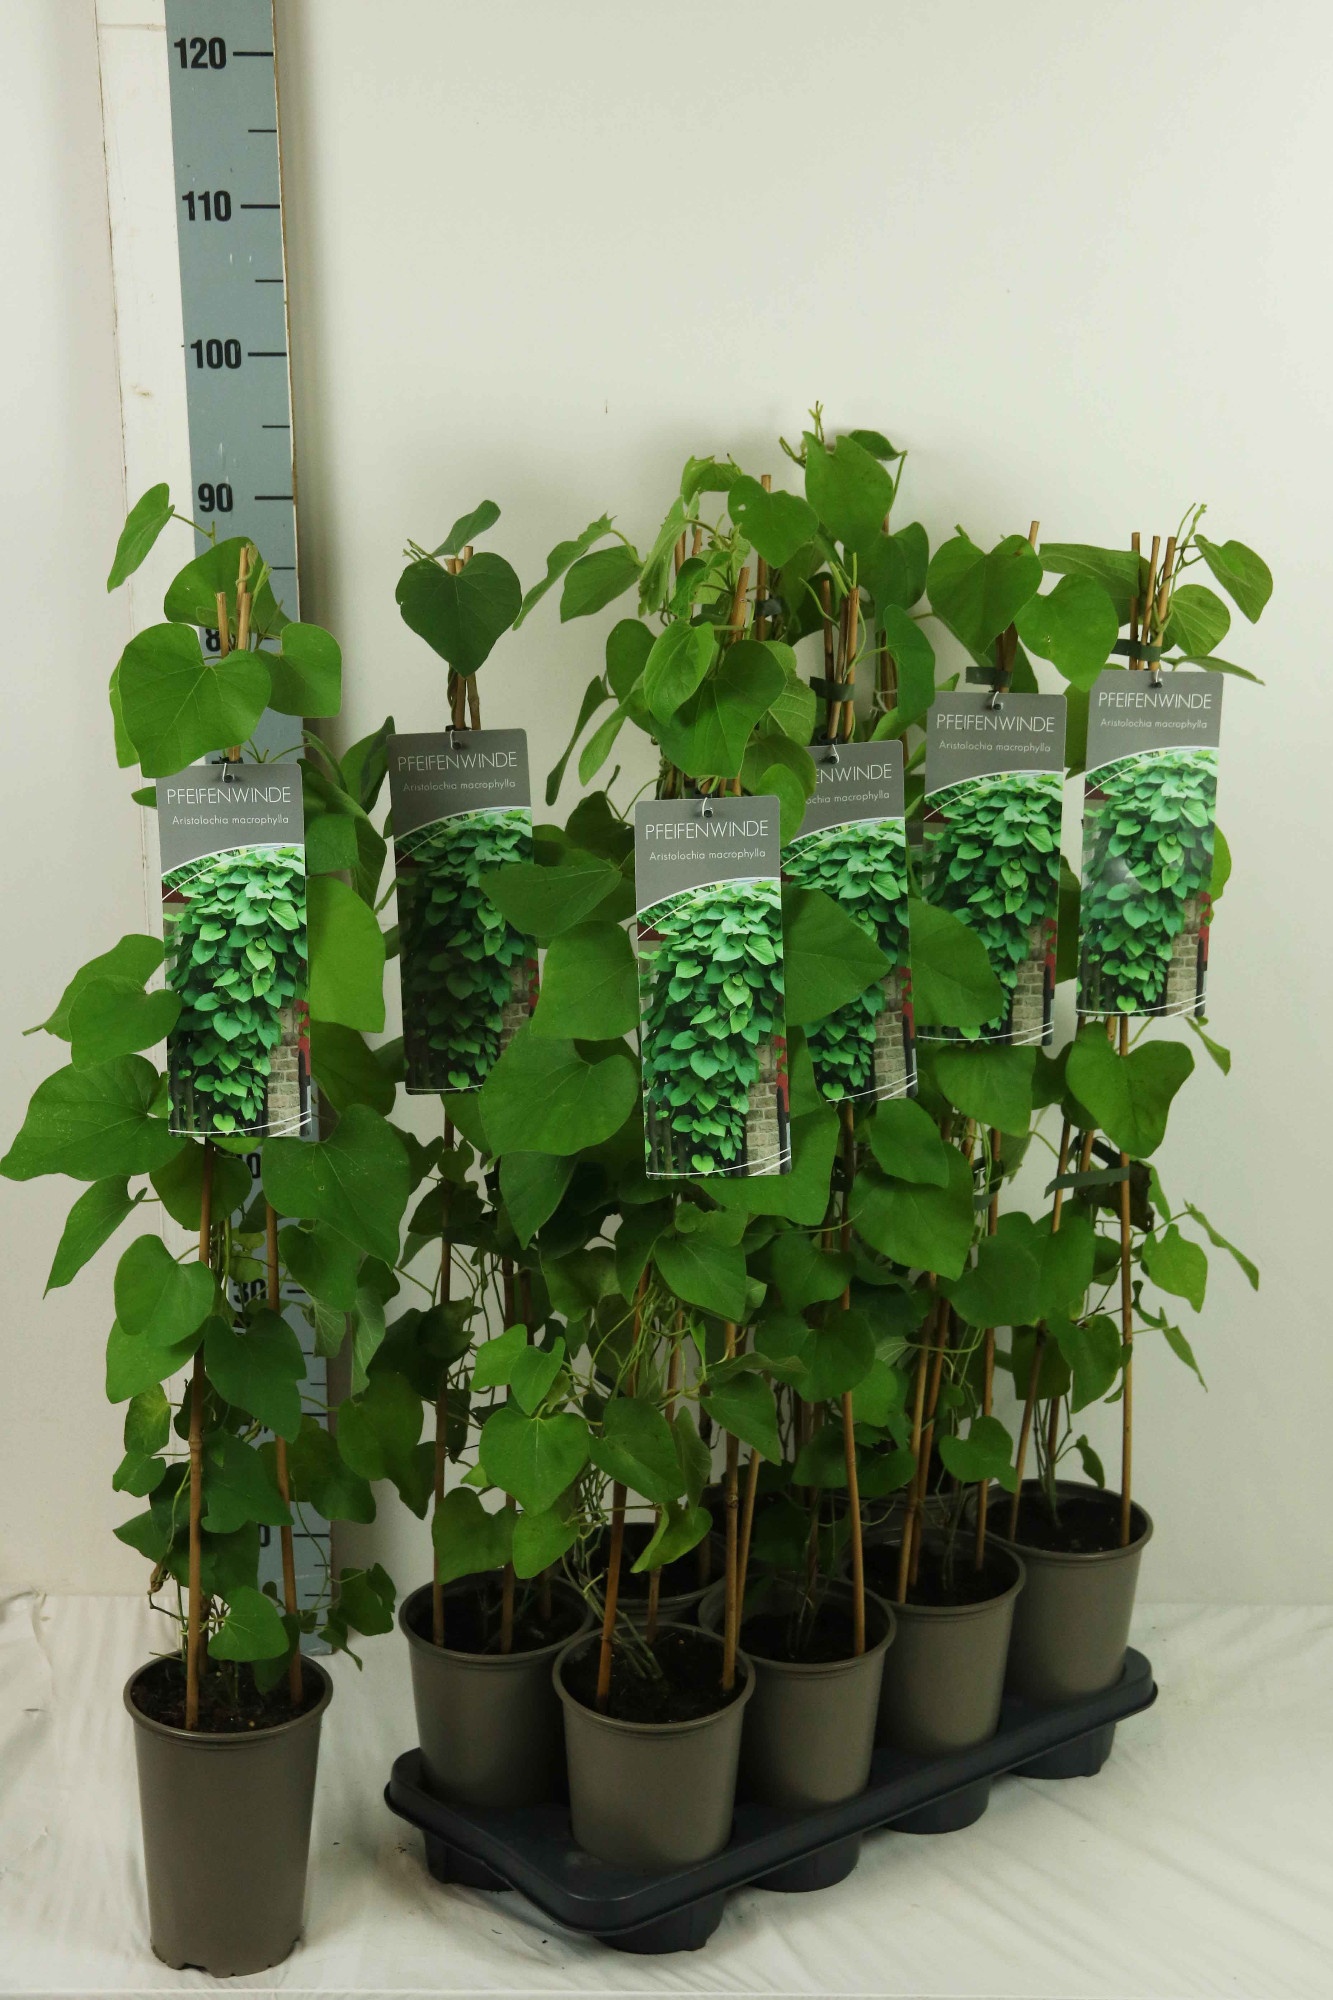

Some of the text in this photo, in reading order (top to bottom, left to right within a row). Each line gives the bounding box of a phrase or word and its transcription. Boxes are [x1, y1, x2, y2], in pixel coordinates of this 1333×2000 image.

[174, 37, 227, 70] 120
[182, 190, 232, 222] 110
[190, 338, 242, 370] 100
[197, 483, 234, 513] 90
[1098, 691, 1212, 709] PFEIFENWINDE
[936, 713, 1055, 732] PFEIFENWINDE
[1100, 718, 1208, 730] Aristolochia macrophylla
[939, 740, 1051, 754] Aristolochia macrophylla
[398, 751, 518, 772] PFEIFENWINDE
[815, 763, 892, 784] NWINDE
[402, 778, 516, 792] Aristolochia macrophylla
[166, 786, 291, 805] PFEIFENWINDE
[834, 790, 890, 802] macrophylla
[172, 814, 289, 826] Aristolochia macrophylla
[645, 820, 769, 840] PFEIFENWINDE
[649, 848, 766, 861] Aristolochia macrophylla
